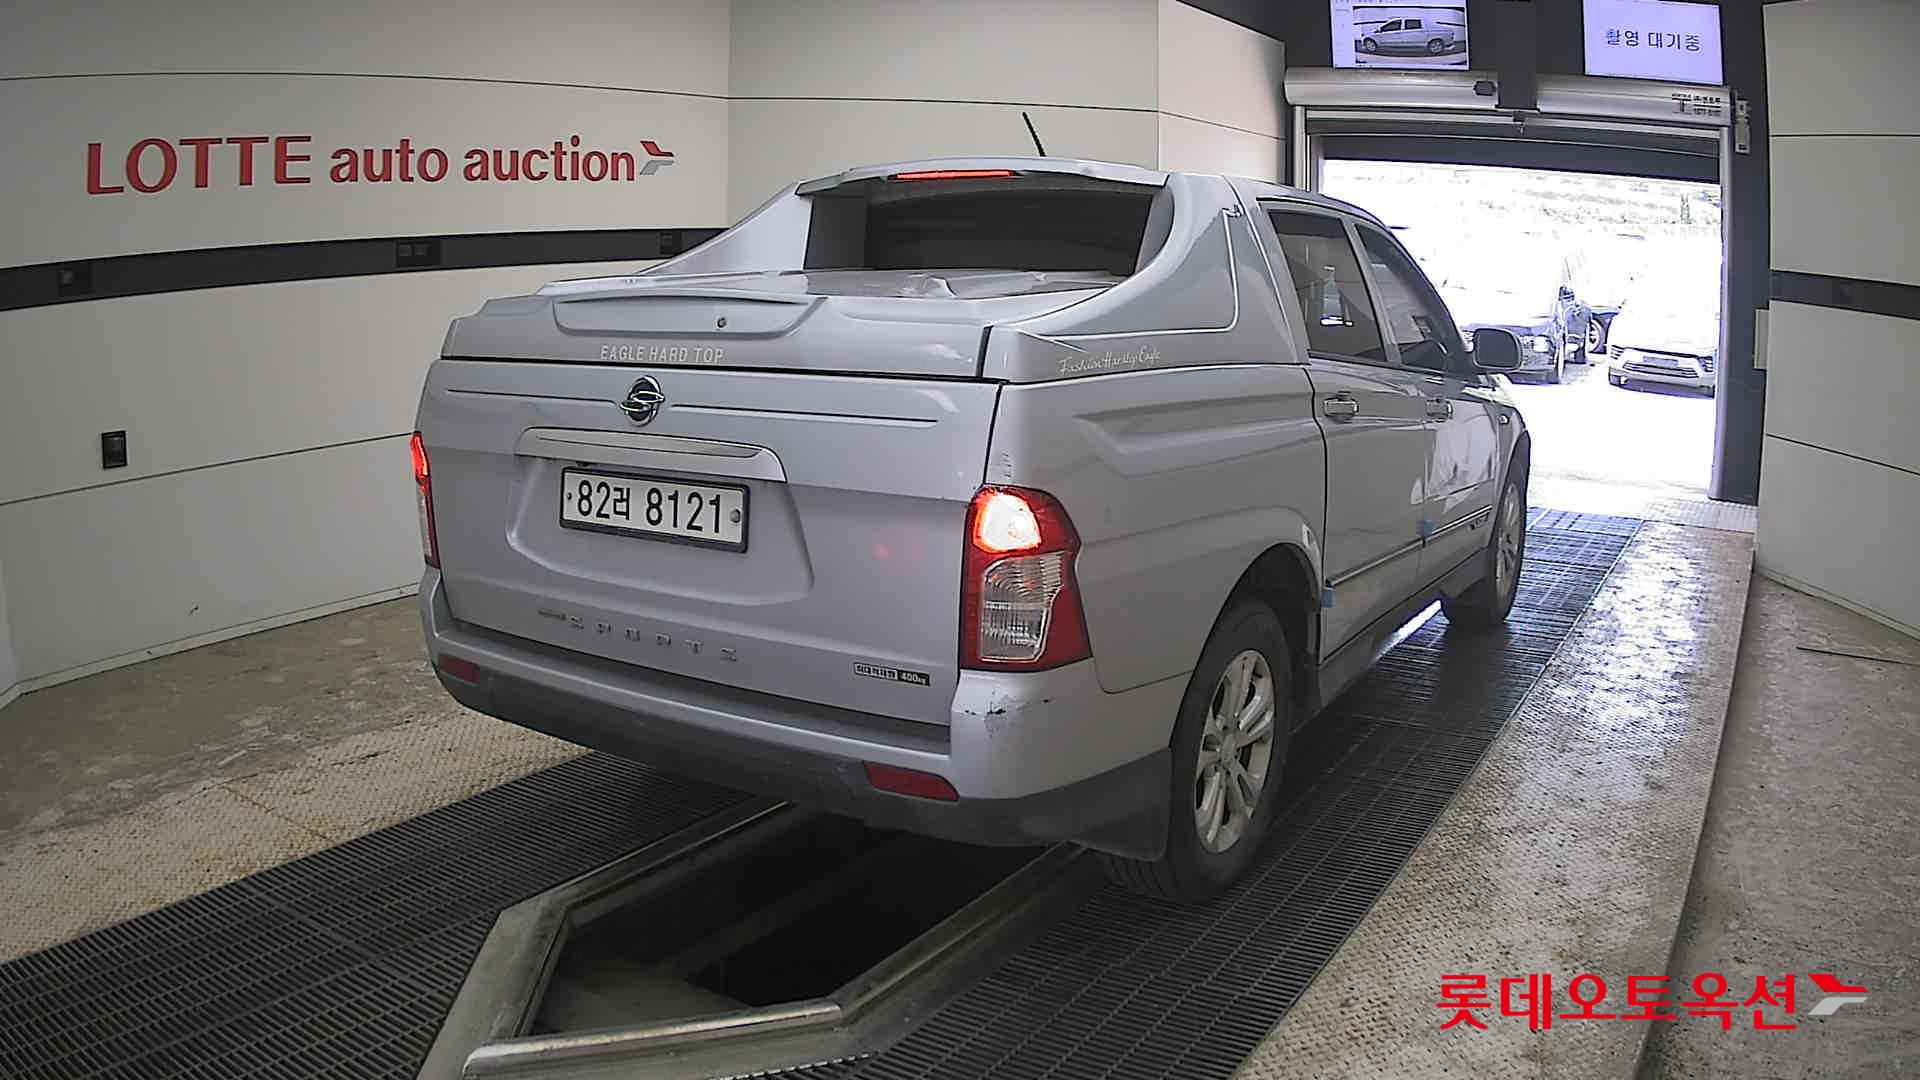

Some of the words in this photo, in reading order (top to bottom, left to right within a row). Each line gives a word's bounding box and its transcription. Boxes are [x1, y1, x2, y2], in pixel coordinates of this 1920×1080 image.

[1605, 28, 1640, 47] 촬영
[1647, 31, 1701, 52] 대기중
[86, 135, 312, 195] LOTTE
[329, 137, 449, 184] auto
[462, 134, 636, 183] auction
[600, 344, 646, 361] EAGLE
[648, 346, 689, 362] HARD
[694, 347, 725, 363] TOP
[576, 478, 631, 521] 82러
[645, 486, 722, 535] 8121
